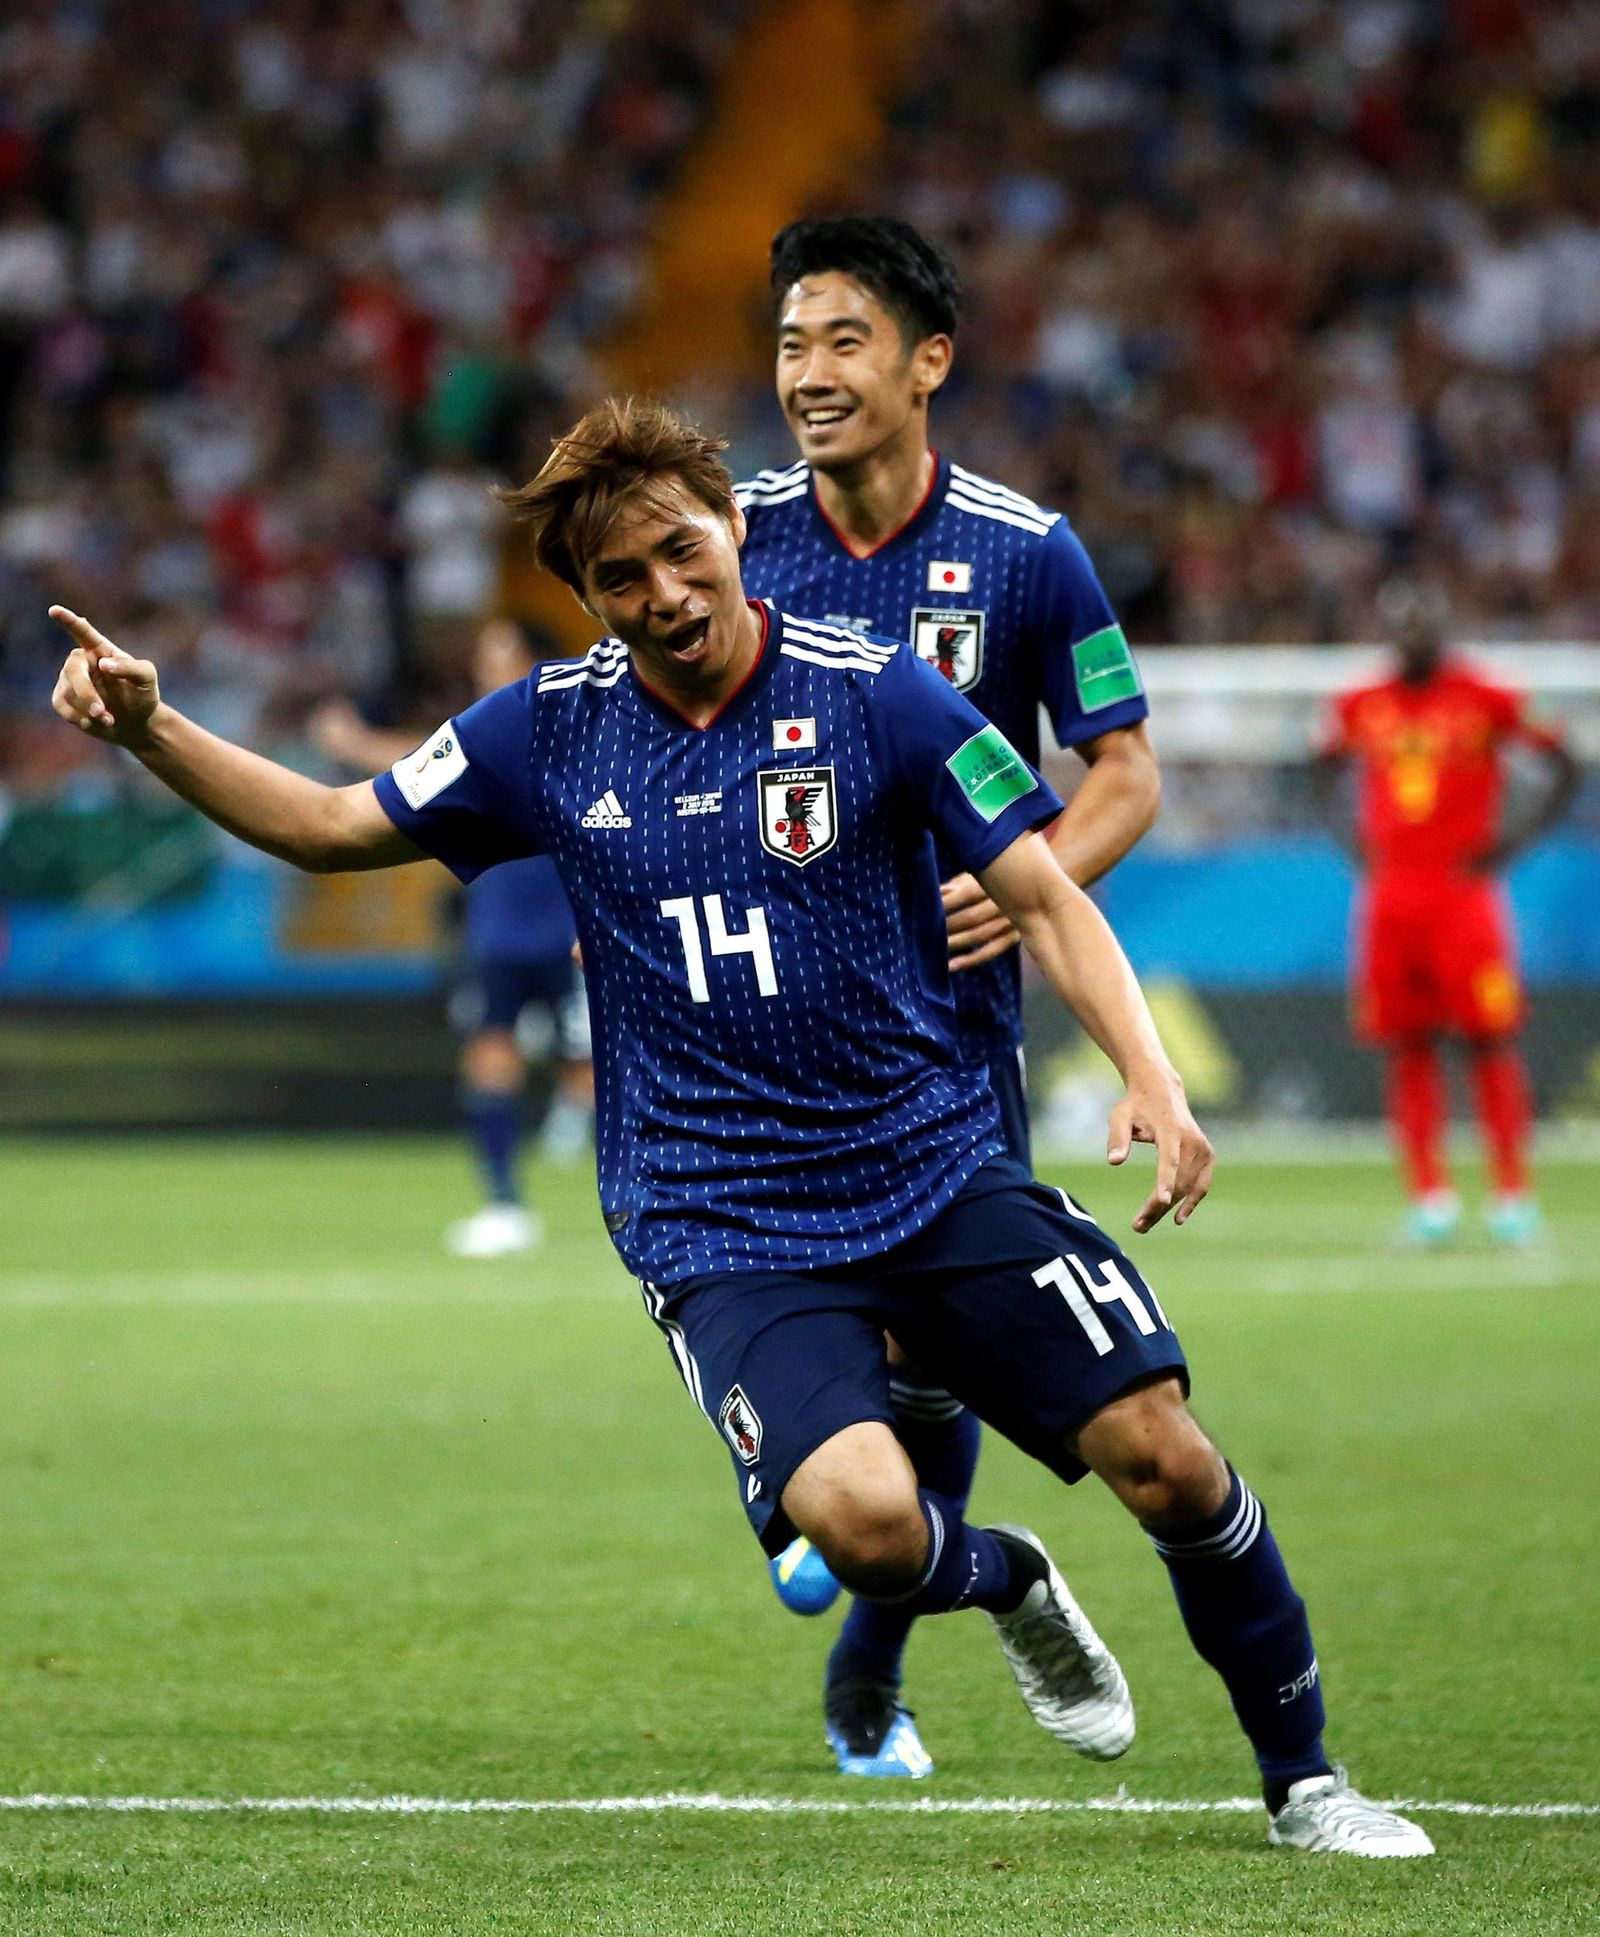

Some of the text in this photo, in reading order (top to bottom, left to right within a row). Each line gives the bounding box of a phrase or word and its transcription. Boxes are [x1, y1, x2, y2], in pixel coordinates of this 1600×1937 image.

[777, 772, 815, 783] JAPAN
[581, 815, 632, 829] adidas
[660, 894, 778, 1002] 14
[1031, 1253, 1157, 1356] 14
